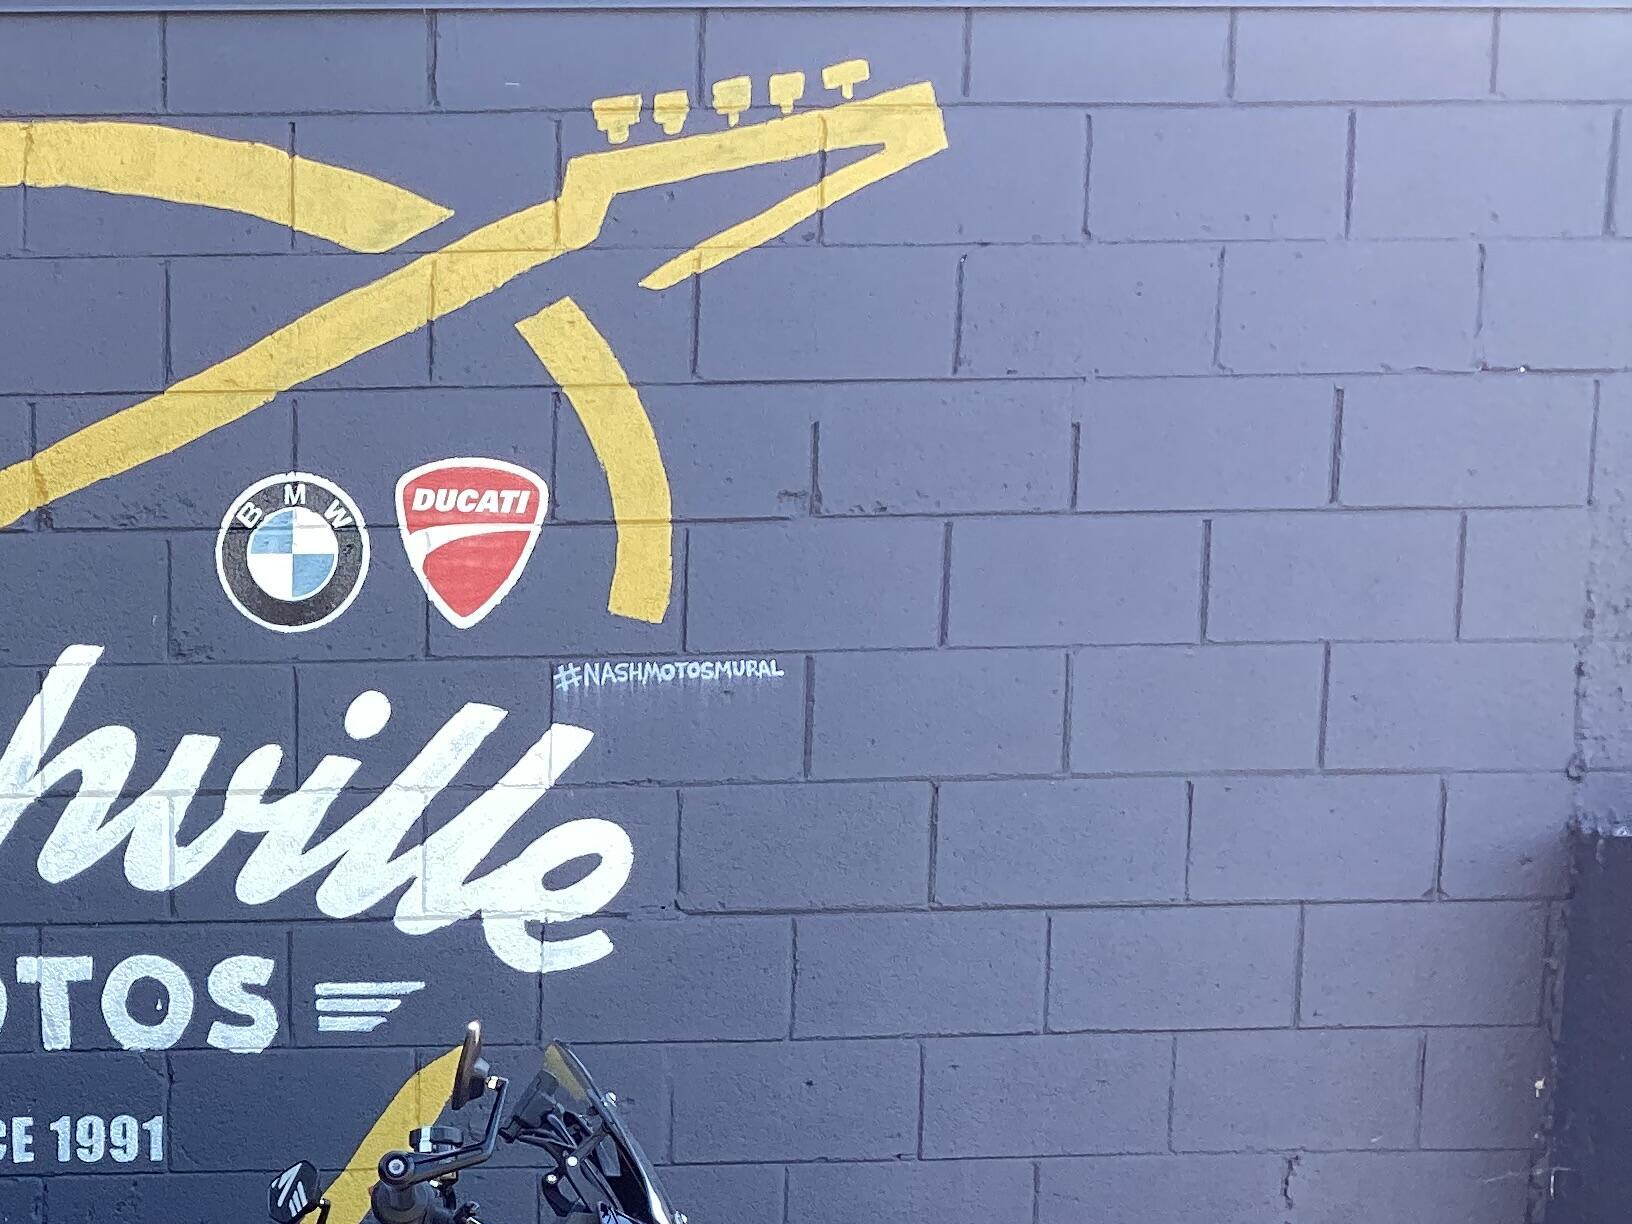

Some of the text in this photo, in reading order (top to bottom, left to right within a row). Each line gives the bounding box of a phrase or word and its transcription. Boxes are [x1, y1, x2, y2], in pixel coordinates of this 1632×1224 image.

[235, 483, 353, 529] BMW
[411, 487, 531, 514] DUCATI
[553, 659, 785, 692] #NASHMOTOSMURAL
[49, 1114, 164, 1164] 1991
